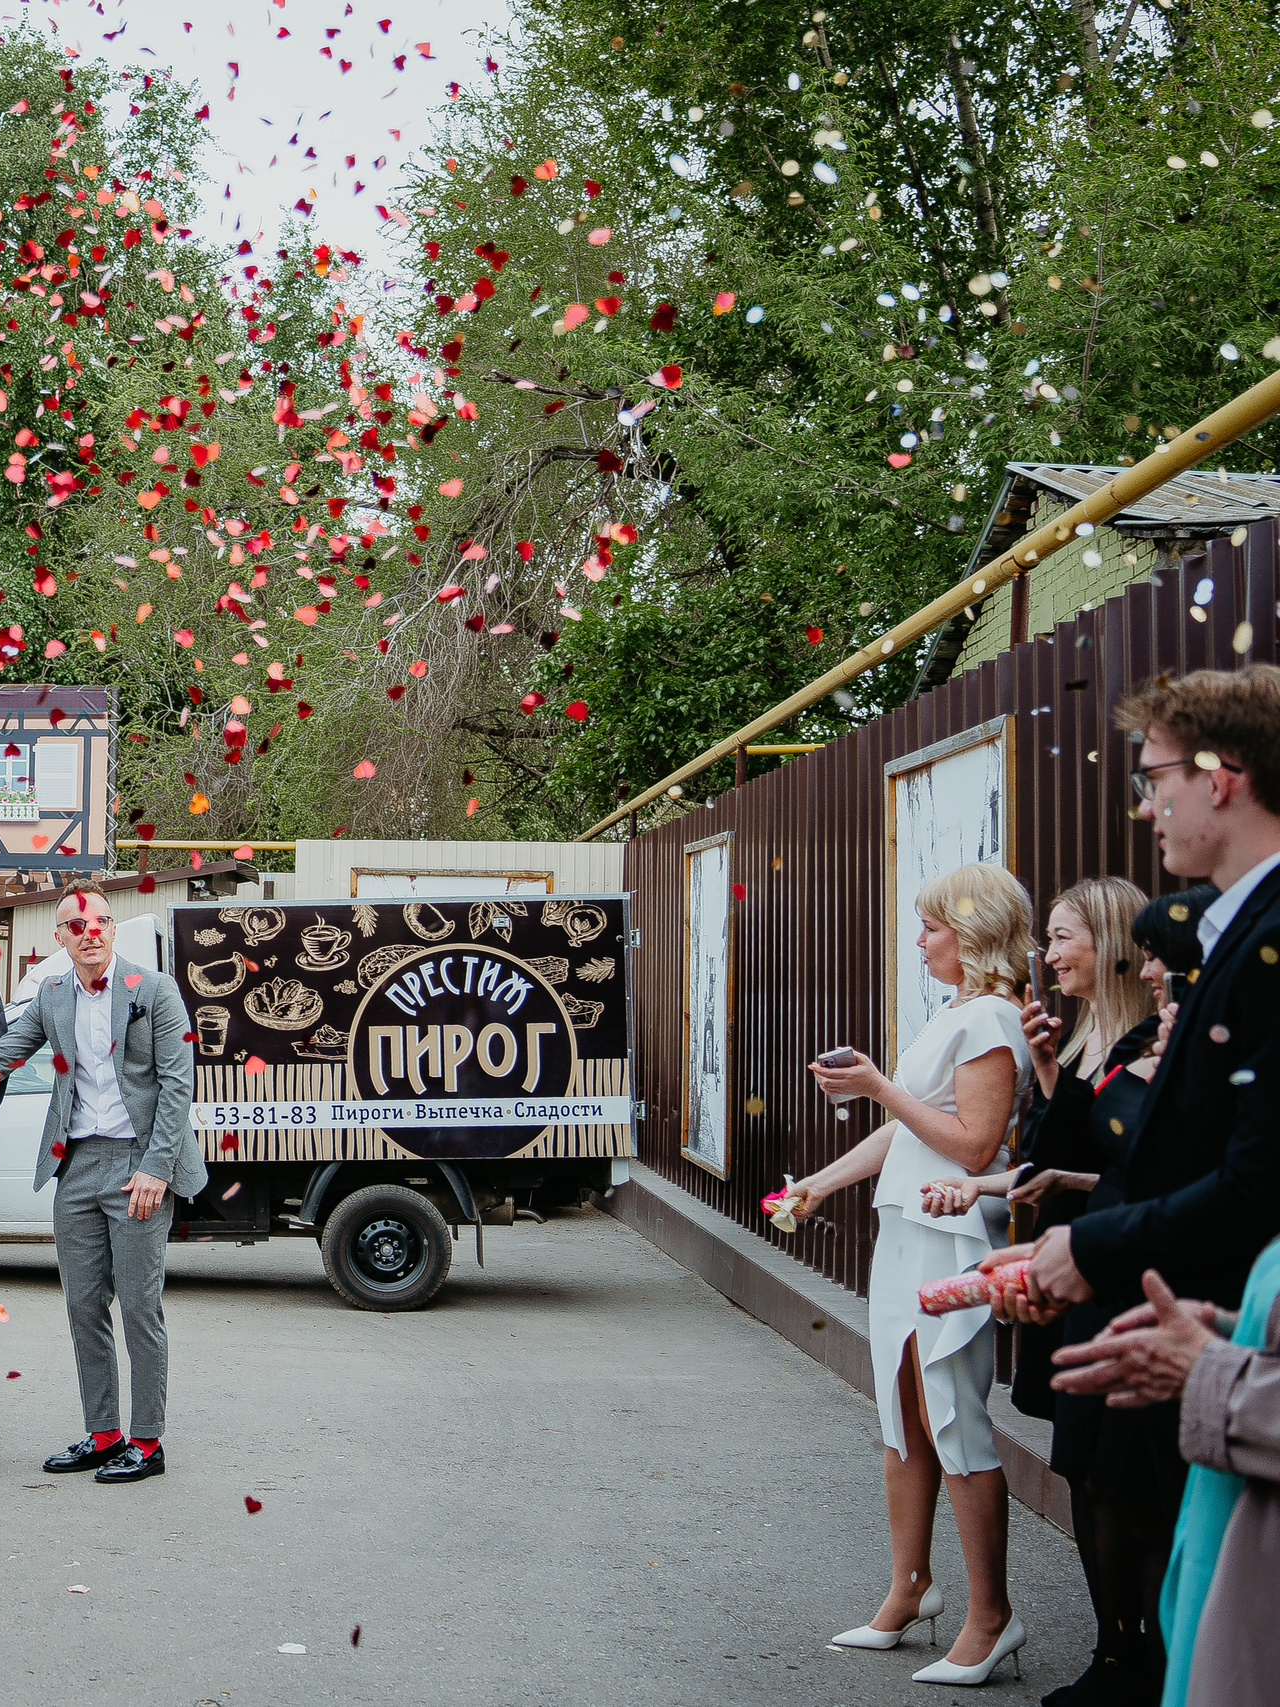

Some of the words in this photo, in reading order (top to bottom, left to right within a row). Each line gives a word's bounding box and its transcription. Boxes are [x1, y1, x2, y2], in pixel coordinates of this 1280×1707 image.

[384, 955, 535, 1017] ПРЕСТИЖ
[368, 1022, 557, 1096] ПИРОГ
[214, 1105, 318, 1126] 53-81-83
[331, 1104, 405, 1124] Пироги
[415, 1103, 504, 1119] Выпечка
[514, 1101, 603, 1121] Сладости
